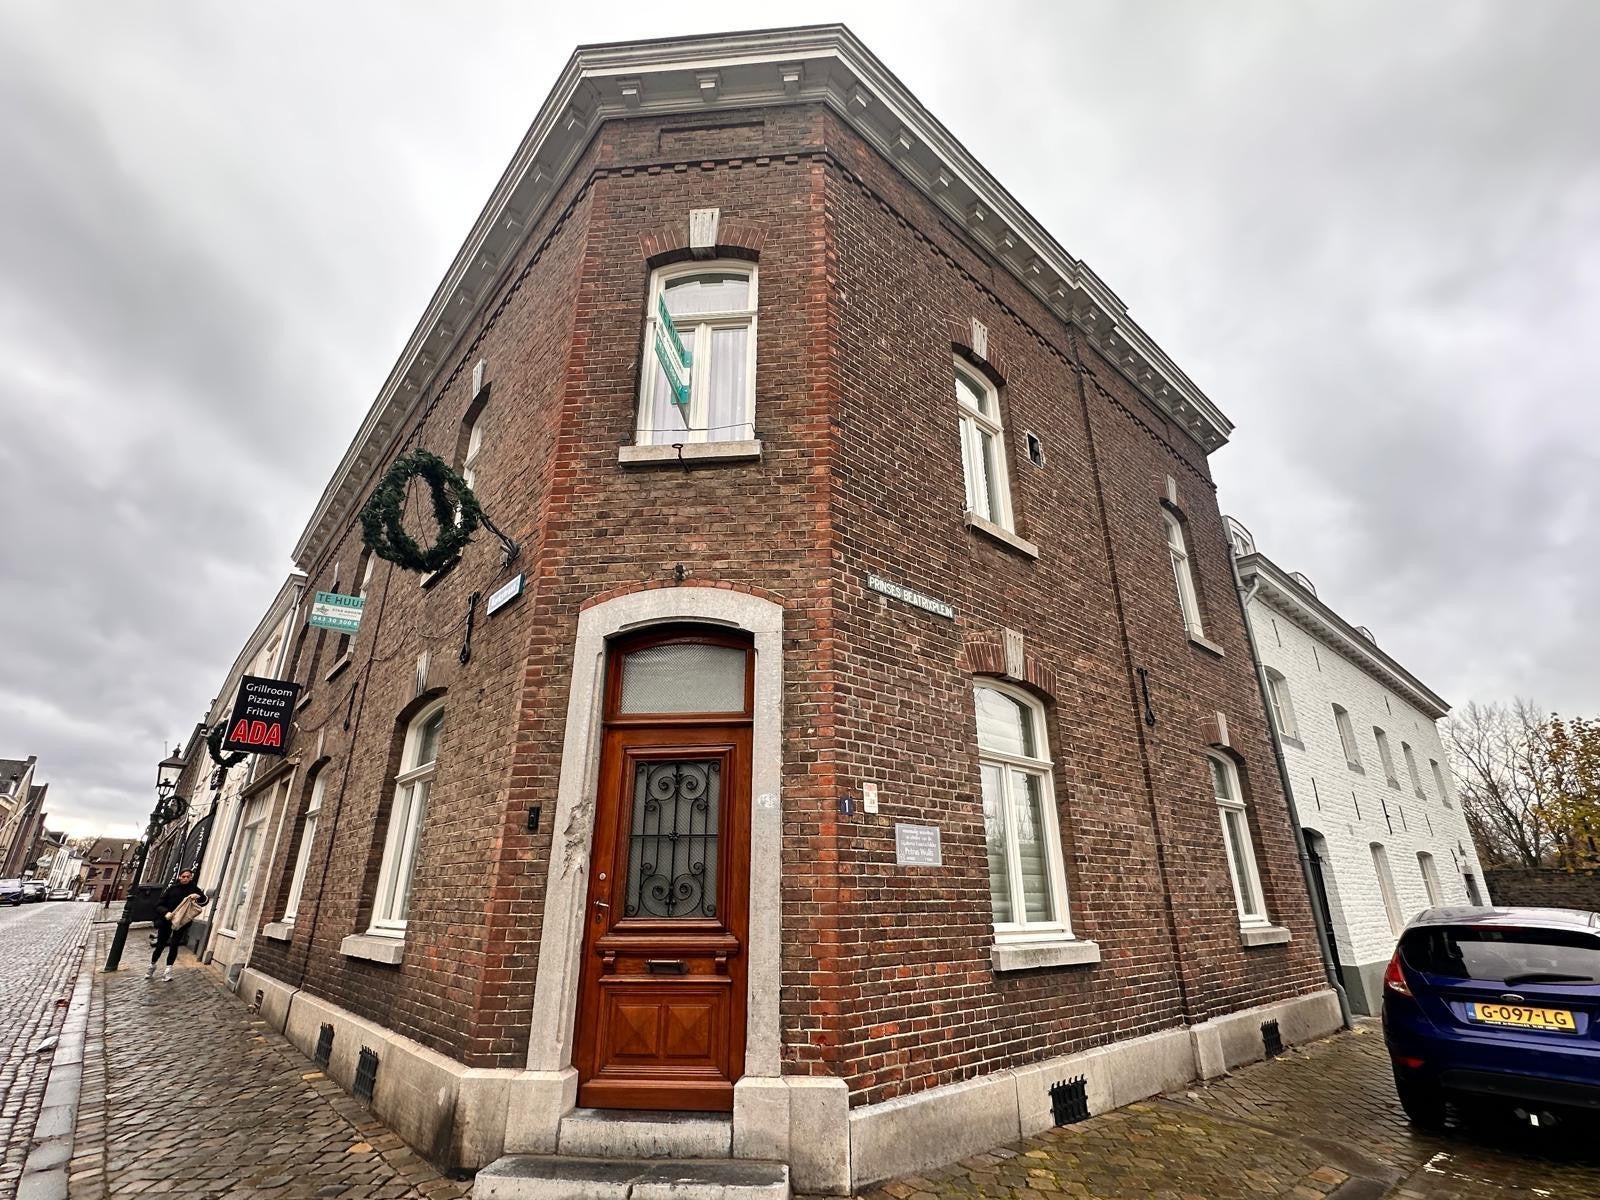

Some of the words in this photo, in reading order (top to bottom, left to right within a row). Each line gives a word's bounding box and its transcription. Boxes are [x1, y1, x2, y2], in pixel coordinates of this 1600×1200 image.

[318, 593, 332, 603] TE
[869, 576, 901, 598] PRINSES
[903, 590, 954, 618] BEATRIXPLEIN
[246, 683, 293, 697] Grillroom
[247, 695, 286, 707] Pizzeria
[246, 707, 280, 718] Friture
[230, 719, 281, 747] ADA
[844, 799, 849, 813] 1
[1481, 1005, 1567, 1025] G-097-LG
